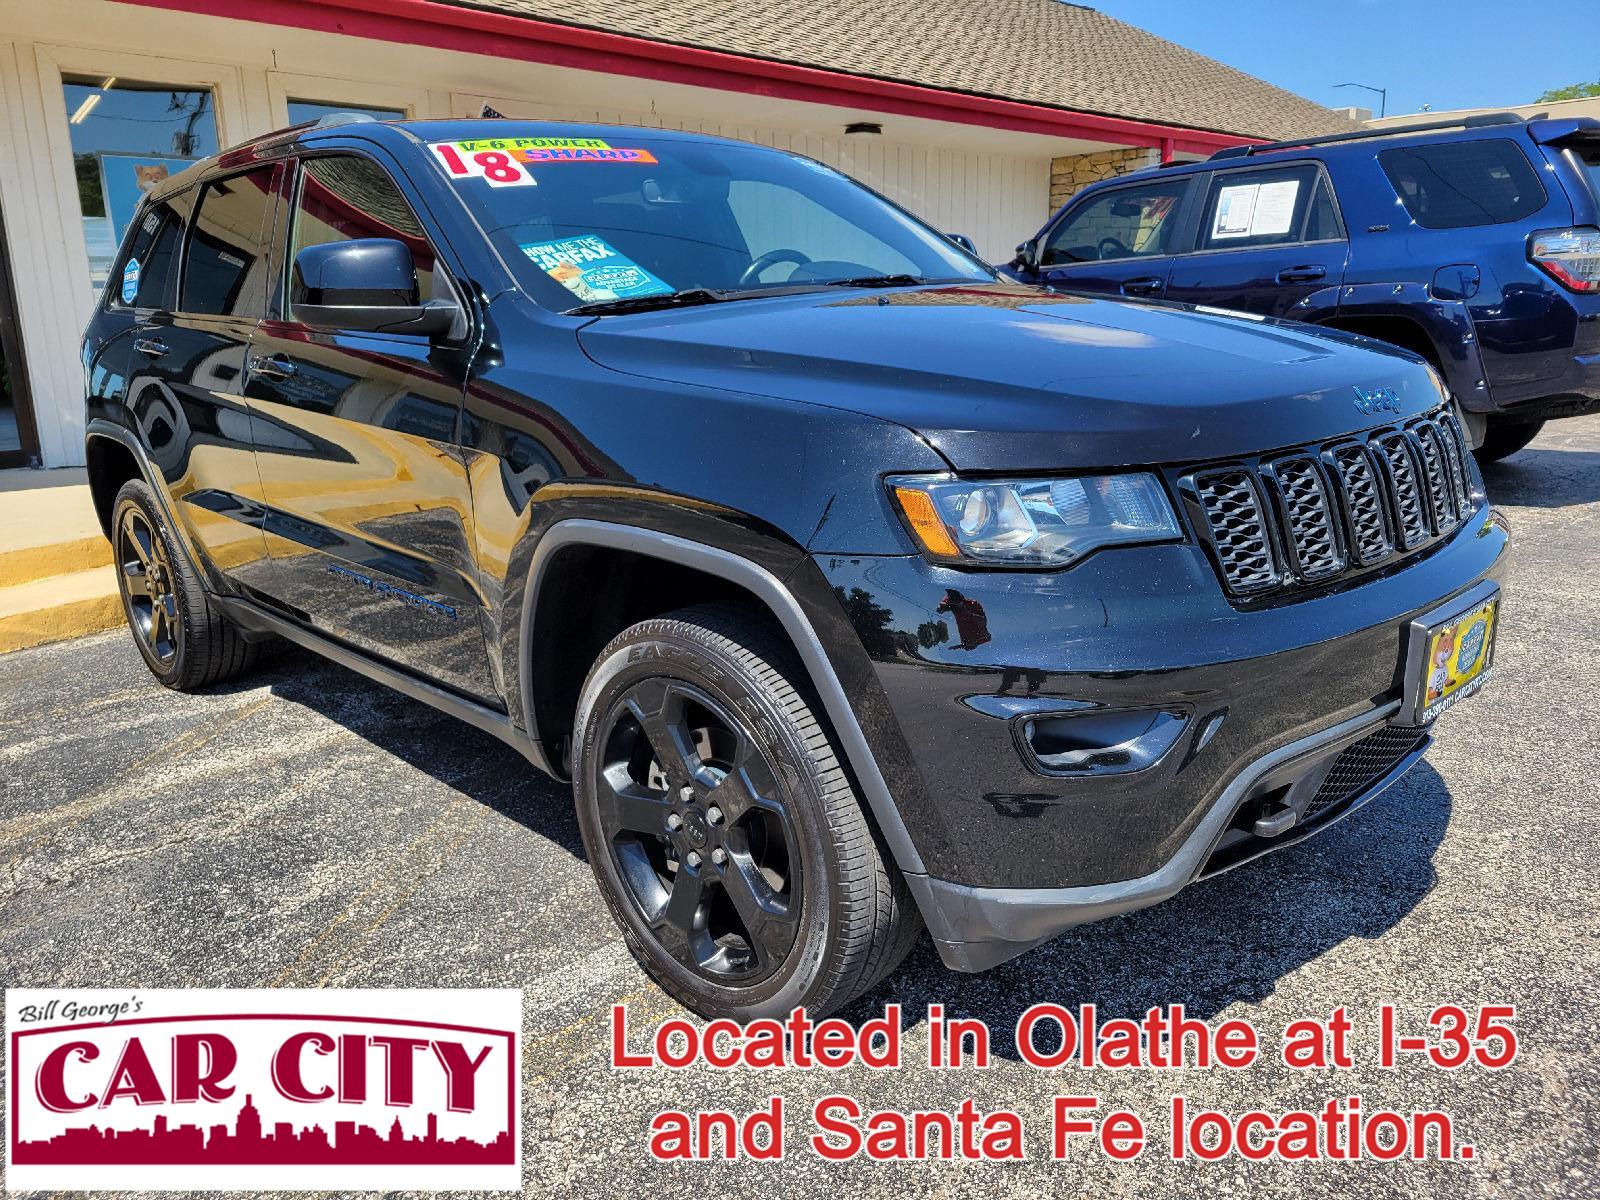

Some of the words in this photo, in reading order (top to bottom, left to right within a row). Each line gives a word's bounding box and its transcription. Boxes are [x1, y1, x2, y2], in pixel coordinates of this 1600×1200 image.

[460, 139, 505, 151] V-6
[514, 137, 602, 148] POWER
[523, 148, 640, 161] SHARP
[522, 243, 557, 257] HOW
[556, 240, 575, 253] ME
[575, 236, 600, 250] THE
